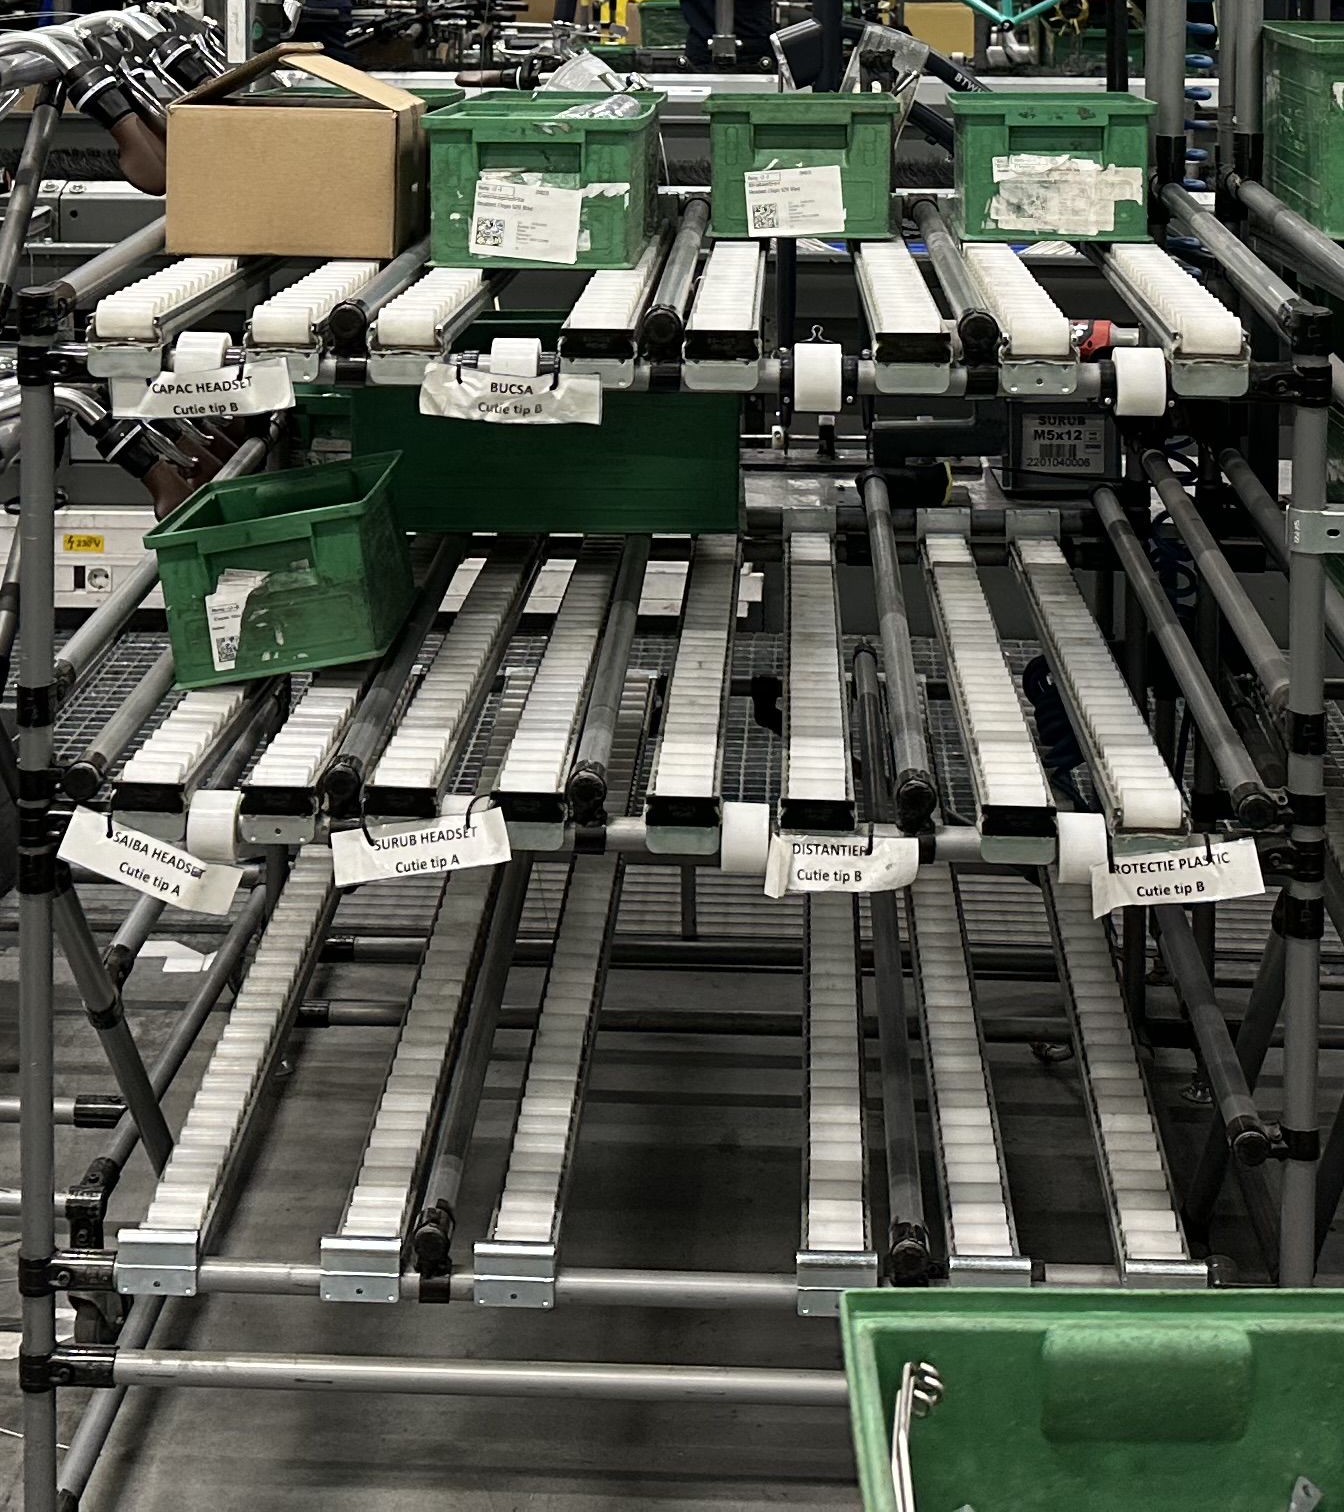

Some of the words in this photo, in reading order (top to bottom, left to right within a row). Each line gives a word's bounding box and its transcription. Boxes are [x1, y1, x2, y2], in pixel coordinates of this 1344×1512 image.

[152, 383, 193, 395] CAPAC
[196, 376, 253, 394] HEADSET
[490, 382, 534, 395] BUCSA
[173, 405, 206, 416] Cutie
[209, 403, 227, 415] tip
[230, 402, 239, 412] B
[478, 402, 510, 415] Cutie
[513, 404, 531, 416] tip
[534, 404, 543, 414] B
[1038, 415, 1087, 426] SURUB
[1033, 429, 1083, 441] M5x12
[374, 834, 417, 851] SURUB
[420, 826, 478, 844] HEADSET
[112, 831, 148, 856] SAIBA
[151, 848, 206, 880] HEADSET
[792, 842, 869, 856] DISTANTIER
[395, 859, 428, 874] Cutie
[430, 856, 447, 871] tip
[450, 854, 460, 865] A
[1113, 859, 1175, 875] ROTECTIE
[118, 861, 151, 884] Cutie
[152, 874, 169, 893] tip
[170, 884, 181, 897] A
[797, 869, 830, 882] Cutie
[833, 870, 850, 884] tip
[854, 870, 862, 882] B
[1136, 885, 1171, 897] Cutie
[1174, 883, 1192, 896] tip
[1196, 881, 1205, 892] B
